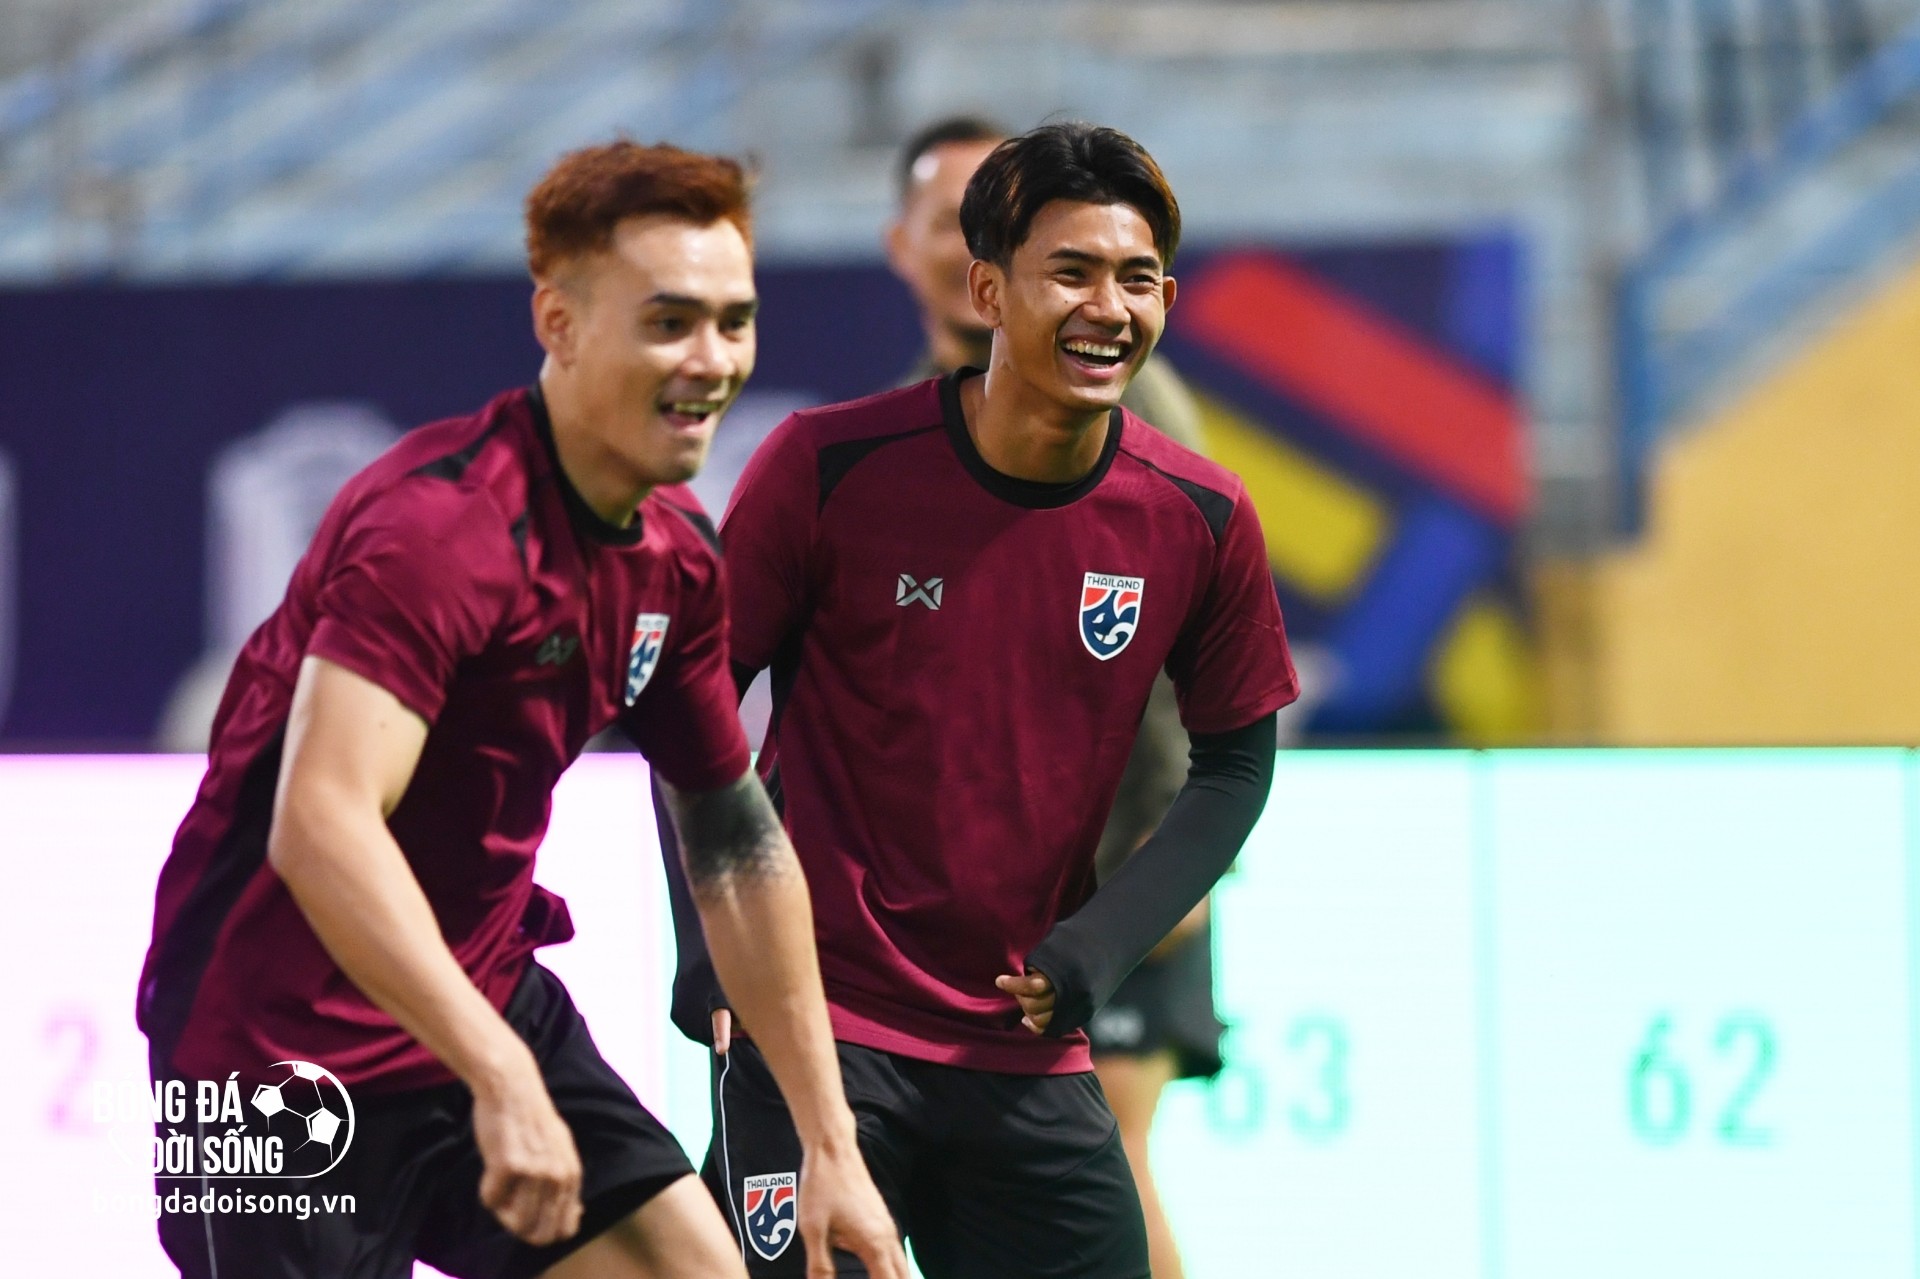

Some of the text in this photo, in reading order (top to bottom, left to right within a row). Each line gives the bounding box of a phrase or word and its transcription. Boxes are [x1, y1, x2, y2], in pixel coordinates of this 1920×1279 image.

[1087, 576, 1141, 590] THAILAND
[1206, 1010, 1349, 1141] 63
[1627, 1009, 1777, 1147] 62
[746, 1176, 793, 1190] THAILAND
